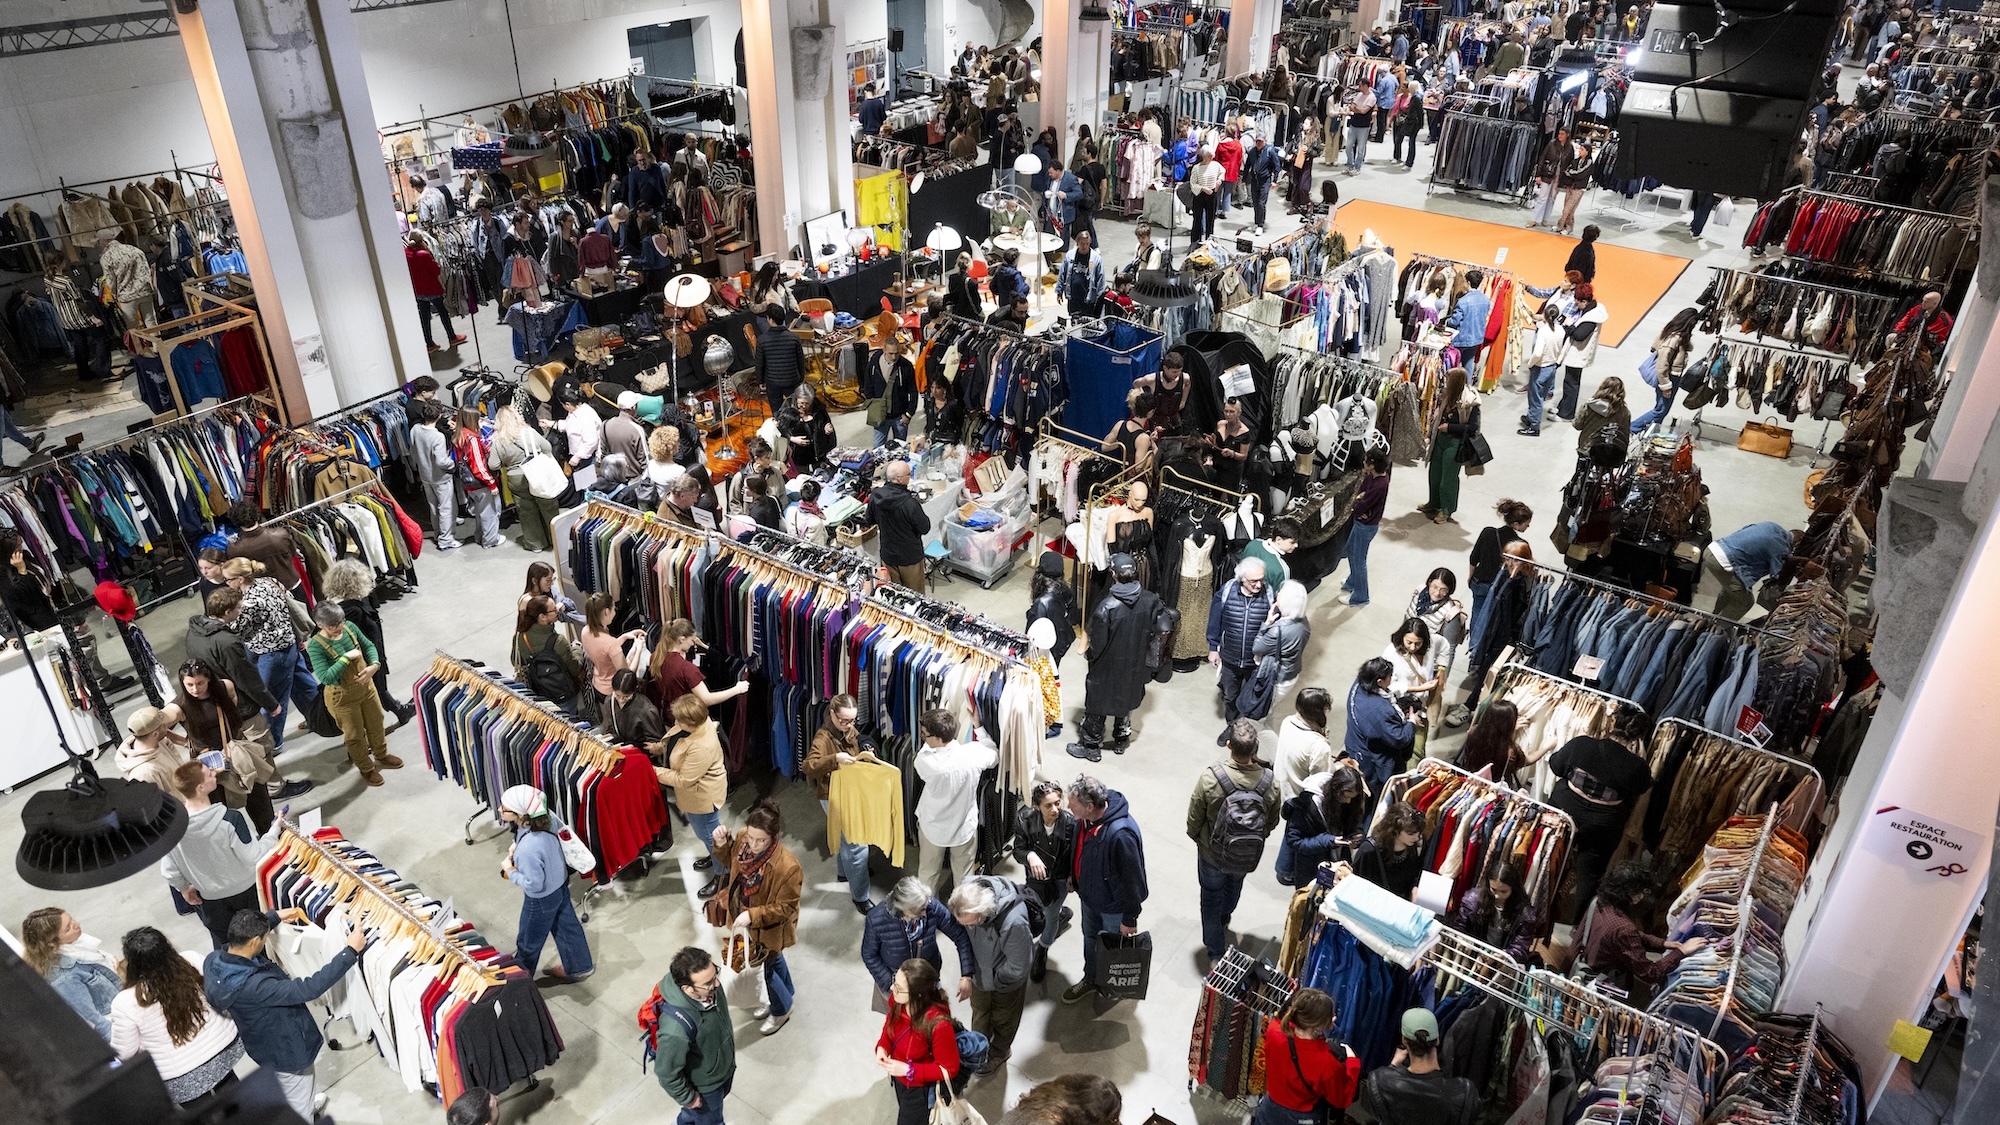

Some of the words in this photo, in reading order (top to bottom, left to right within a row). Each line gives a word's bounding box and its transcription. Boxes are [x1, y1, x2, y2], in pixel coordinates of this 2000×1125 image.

[1890, 822, 1963, 851] RESTAURATION
[1910, 820, 1947, 837] ESPACE
[1107, 974, 1140, 986] ARIÉ
